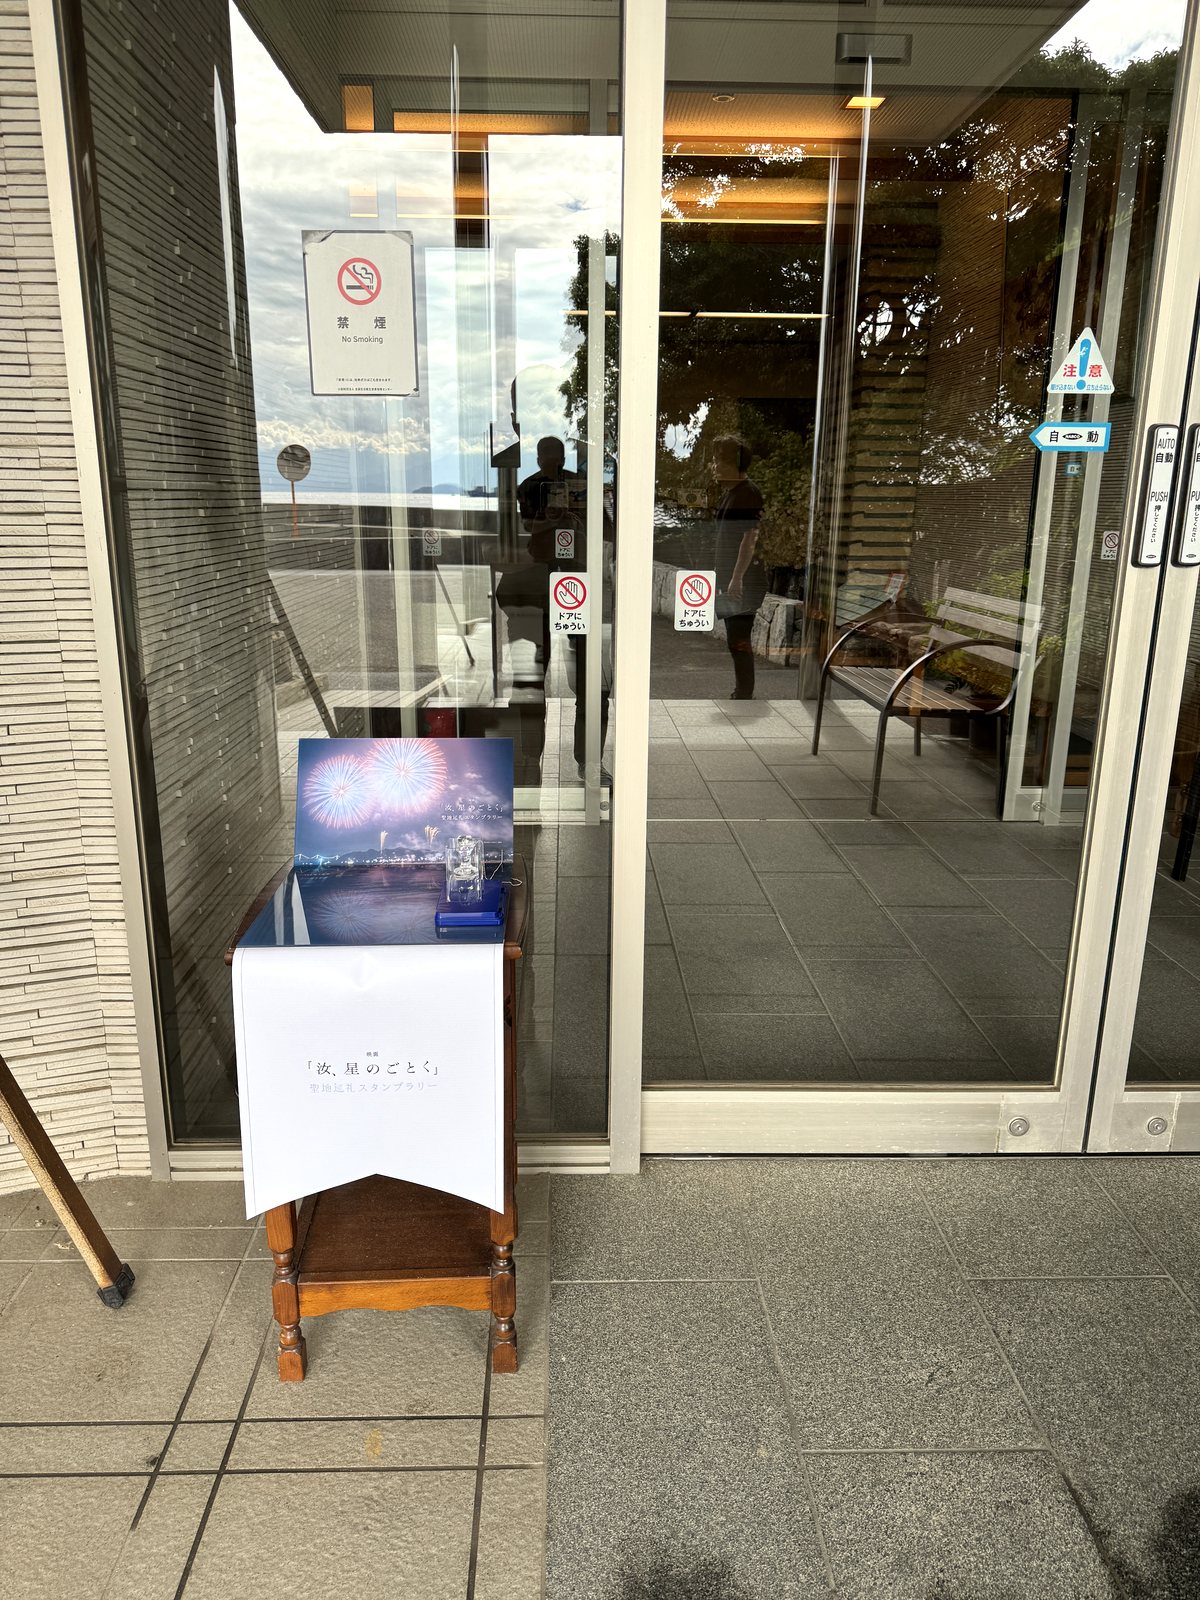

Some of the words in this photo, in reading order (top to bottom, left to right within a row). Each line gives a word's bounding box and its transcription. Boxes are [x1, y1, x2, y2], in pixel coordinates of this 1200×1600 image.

[353, 335, 383, 344] Smoking
[1158, 438, 1176, 449] AUTO
[1155, 452, 1174, 463] 自動
[1151, 491, 1169, 502] PUSH
[1191, 491, 1200, 502] PU
[559, 612, 582, 620] ドアに
[554, 622, 586, 630] ちゅうい
[679, 619, 709, 627] ちゅうい
